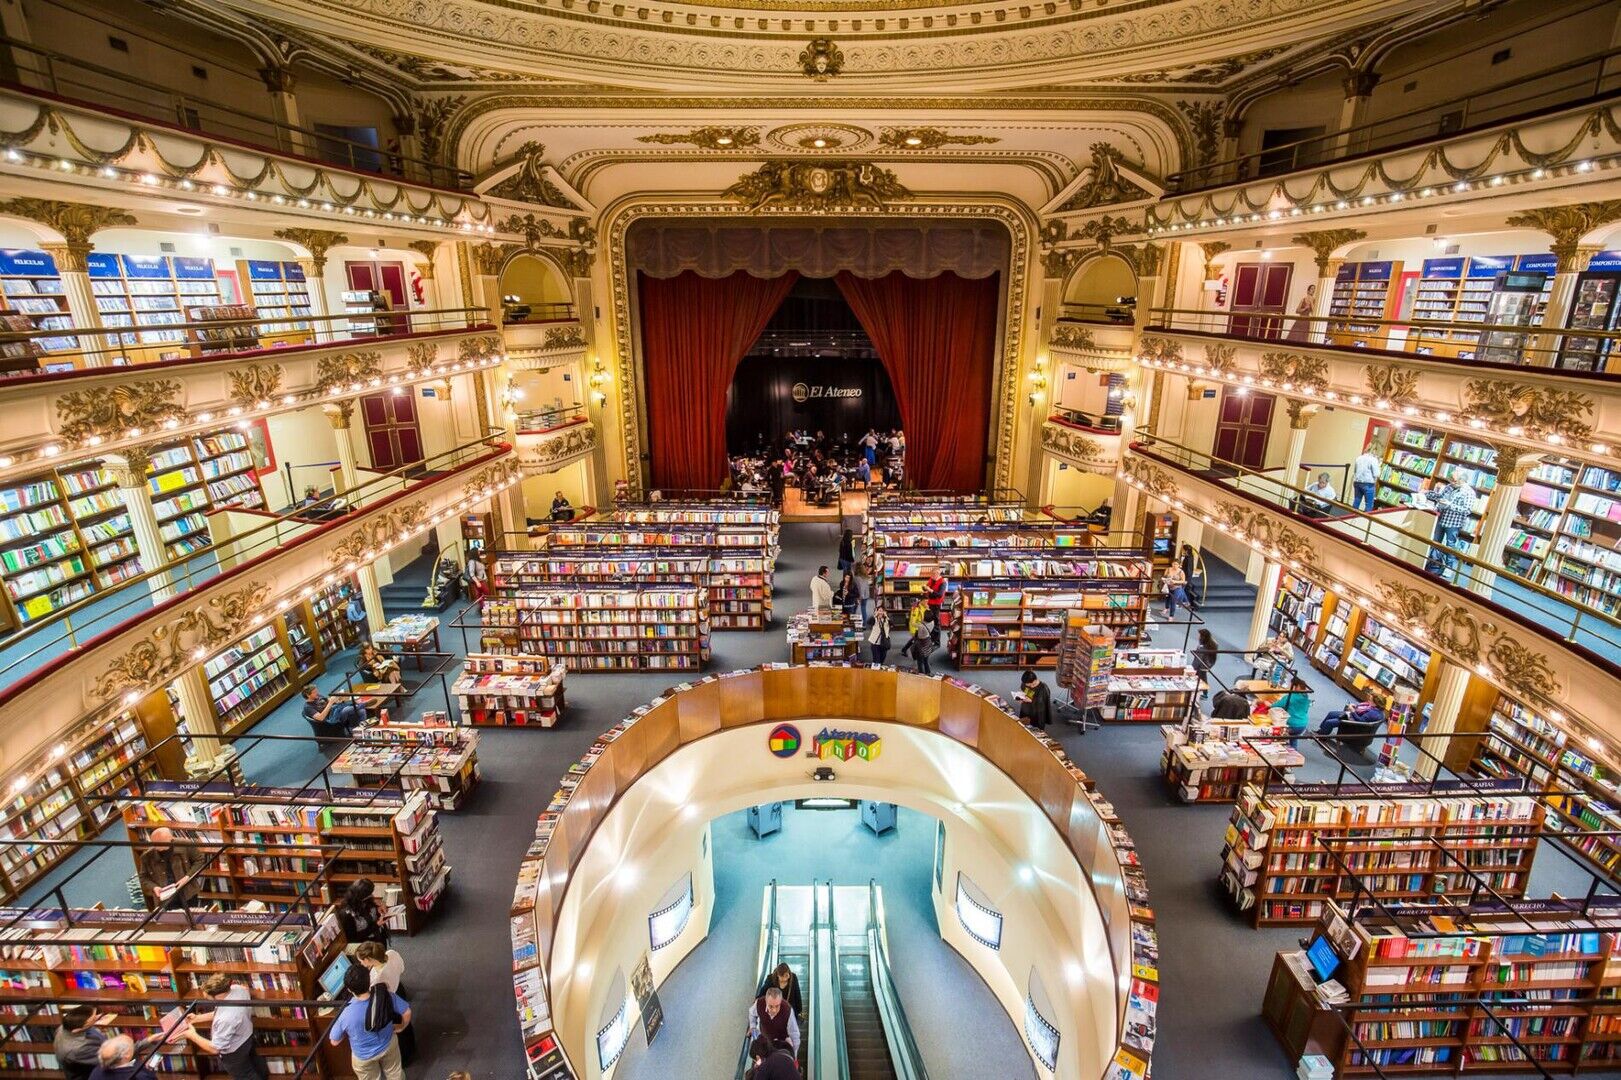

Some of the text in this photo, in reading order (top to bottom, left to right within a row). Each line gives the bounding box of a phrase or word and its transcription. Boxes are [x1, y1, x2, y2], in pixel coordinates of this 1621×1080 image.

[810, 386, 863, 398] El Ateneo
[817, 727, 879, 741] Ateneo
